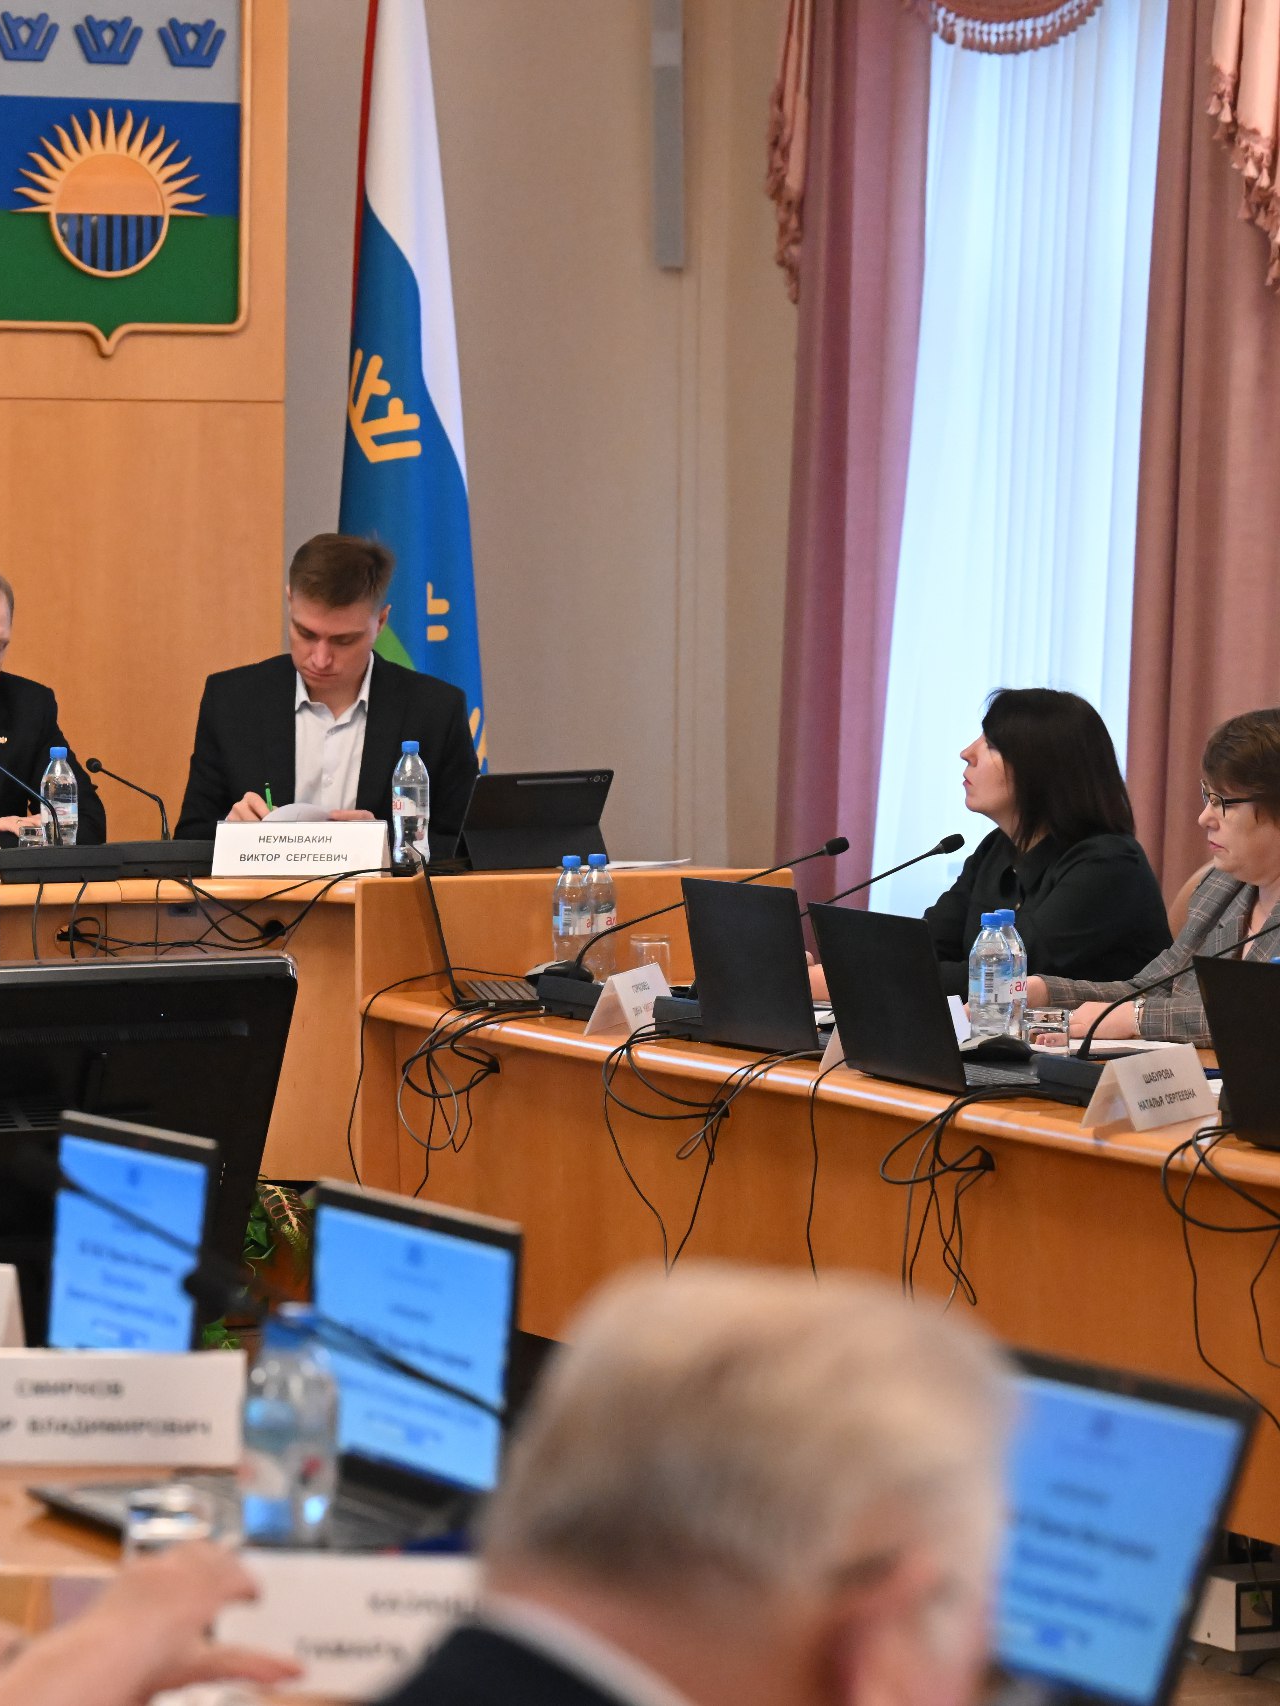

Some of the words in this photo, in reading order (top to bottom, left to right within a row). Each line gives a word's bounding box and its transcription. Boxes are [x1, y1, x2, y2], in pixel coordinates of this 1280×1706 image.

[258, 835, 333, 844] НЕУМЫВАКИН
[239, 853, 281, 862] ВИКТОР
[286, 853, 348, 862] СЕРГЕЕВИЧ
[1142, 1067, 1176, 1084] ШАБУРОВА
[1137, 1095, 1164, 1112] НАТАЛЬЯ
[1164, 1088, 1197, 1105] СЕРГЕЕВНА
